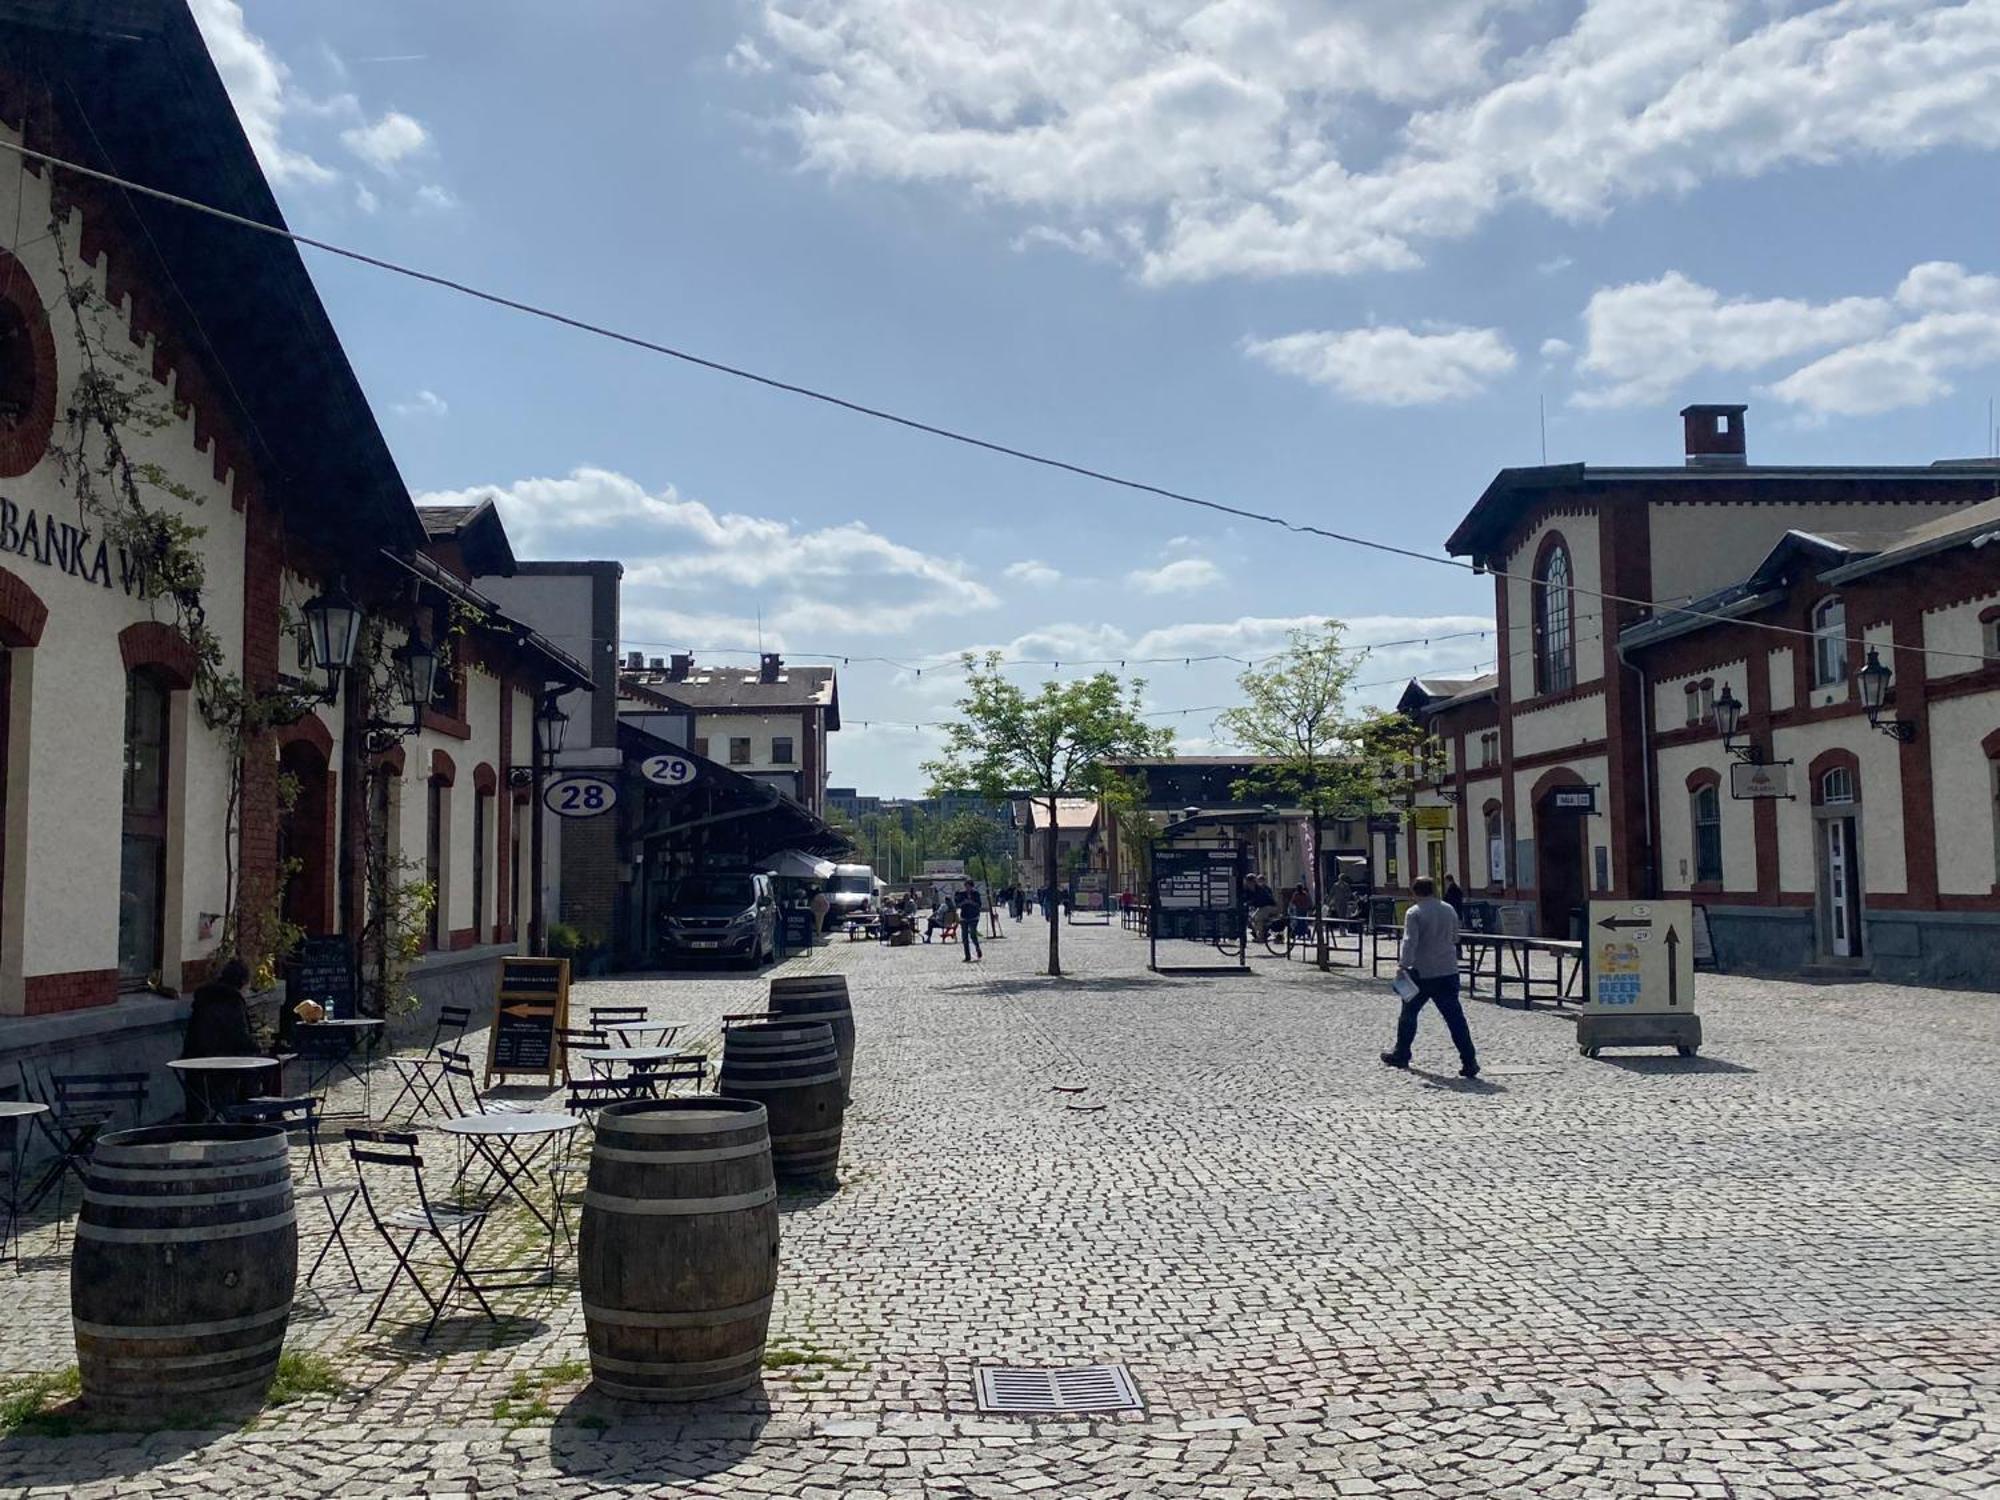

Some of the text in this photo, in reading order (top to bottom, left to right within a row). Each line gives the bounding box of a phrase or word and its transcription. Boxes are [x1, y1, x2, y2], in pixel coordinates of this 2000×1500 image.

[0, 497, 113, 588] BANKA
[652, 759, 687, 781] 29
[561, 785, 604, 810] 28
[1598, 973, 1640, 981] PRAGUE
[1598, 982, 1641, 993] BEER
[1599, 993, 1637, 1004] FEST
